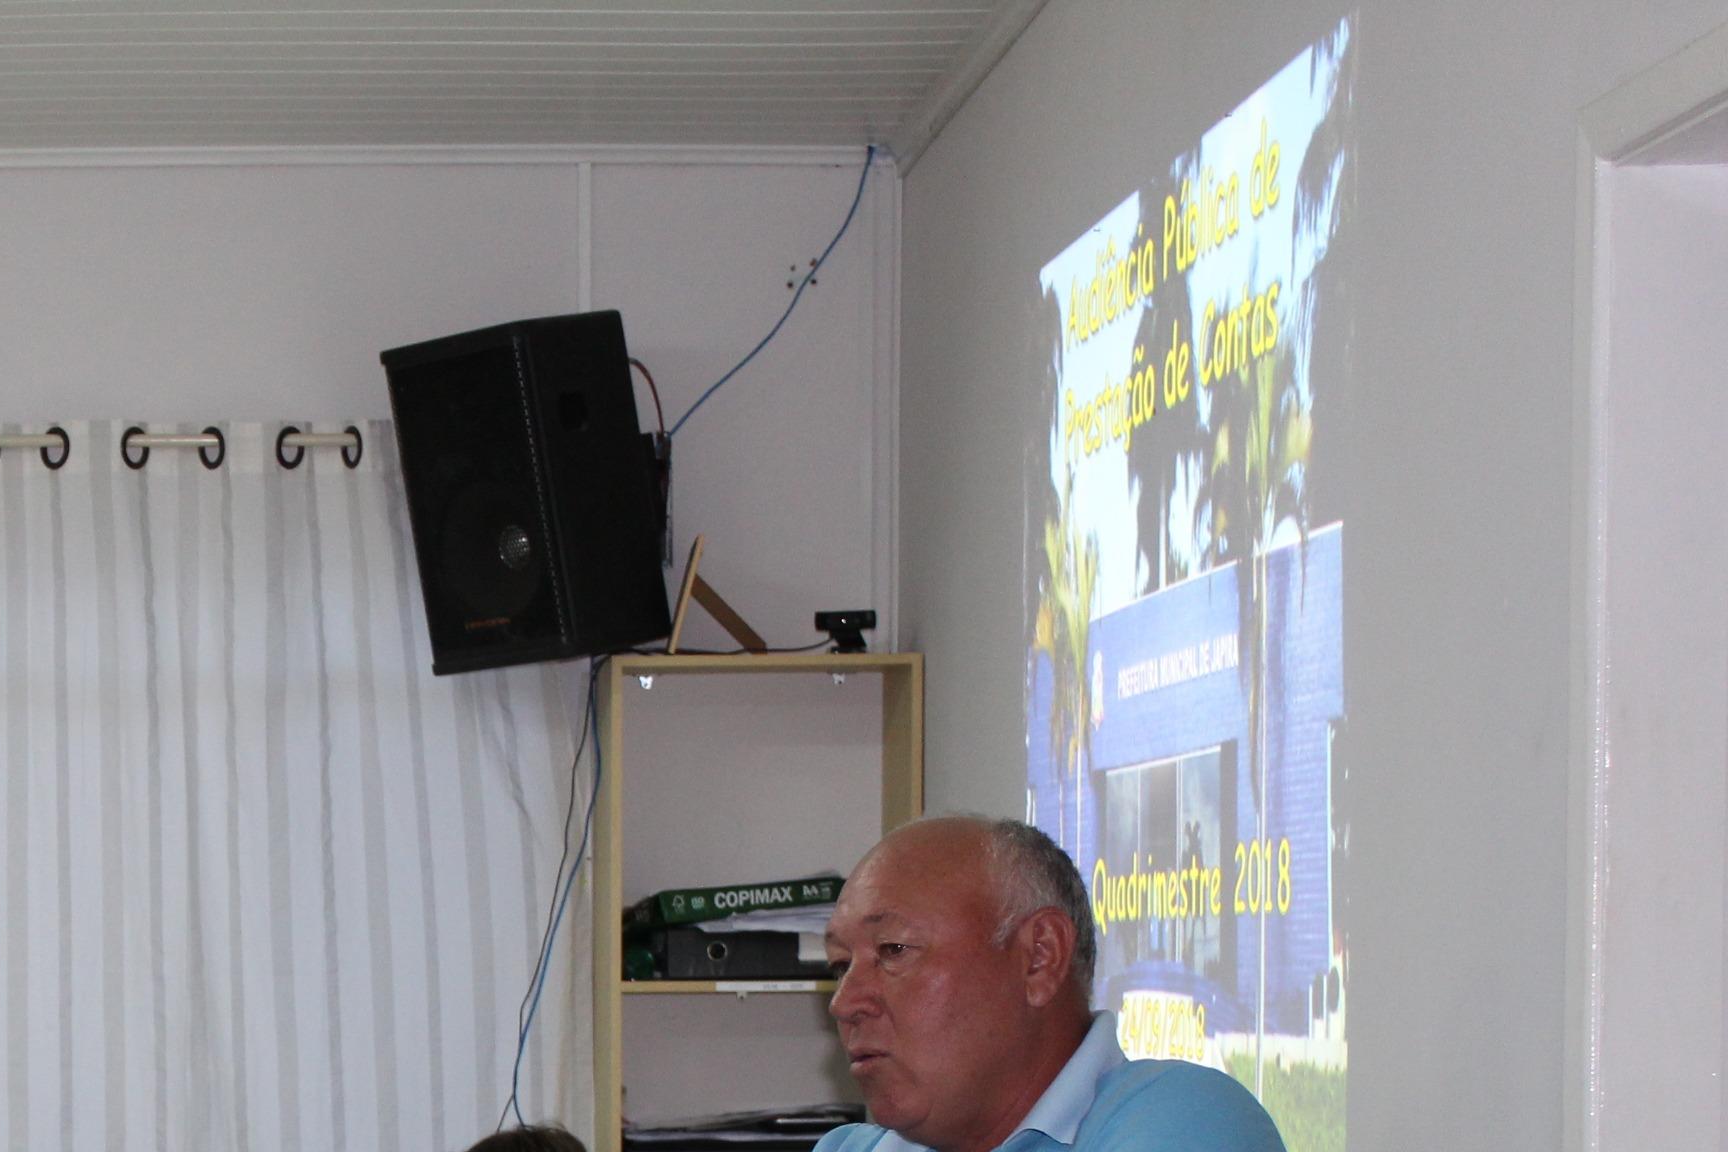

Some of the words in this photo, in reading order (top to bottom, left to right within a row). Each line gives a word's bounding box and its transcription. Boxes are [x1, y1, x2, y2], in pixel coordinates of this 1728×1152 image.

[1066, 222, 1154, 352] Audiência
[1163, 165, 1240, 284] Pública
[1250, 116, 1281, 218] de
[1065, 343, 1156, 465] Prestação
[1163, 318, 1190, 410] de
[1199, 280, 1280, 386] Contas
[713, 886, 793, 909] COPIMAX
[1092, 851, 1222, 937] Quadrimestre
[1234, 837, 1292, 915] 2018
